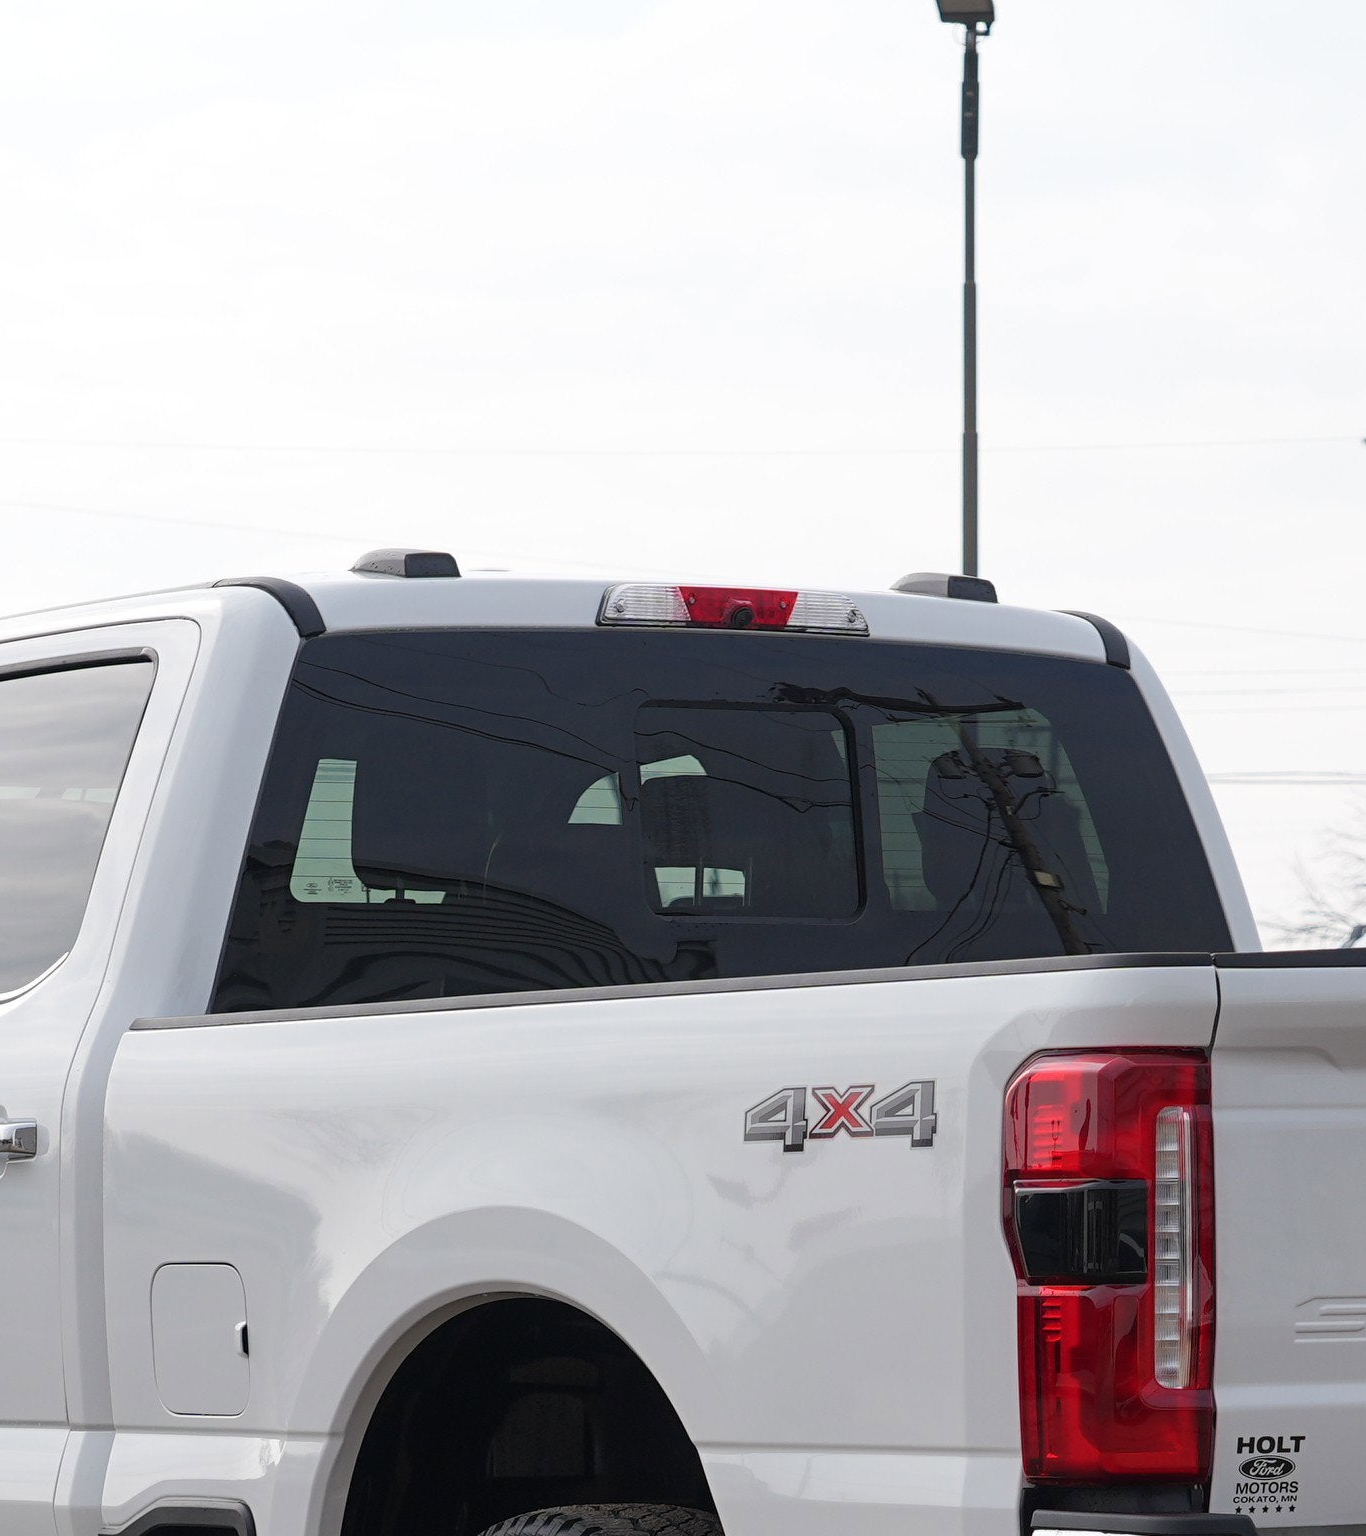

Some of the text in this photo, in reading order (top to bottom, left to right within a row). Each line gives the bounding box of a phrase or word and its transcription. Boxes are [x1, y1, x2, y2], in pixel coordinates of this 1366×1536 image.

[743, 1079, 937, 1152] 4X4
[1236, 1435, 1306, 1454] HOLT
[1235, 1481, 1299, 1495] MOTORS
[1232, 1495, 1279, 1504] COKATO,
